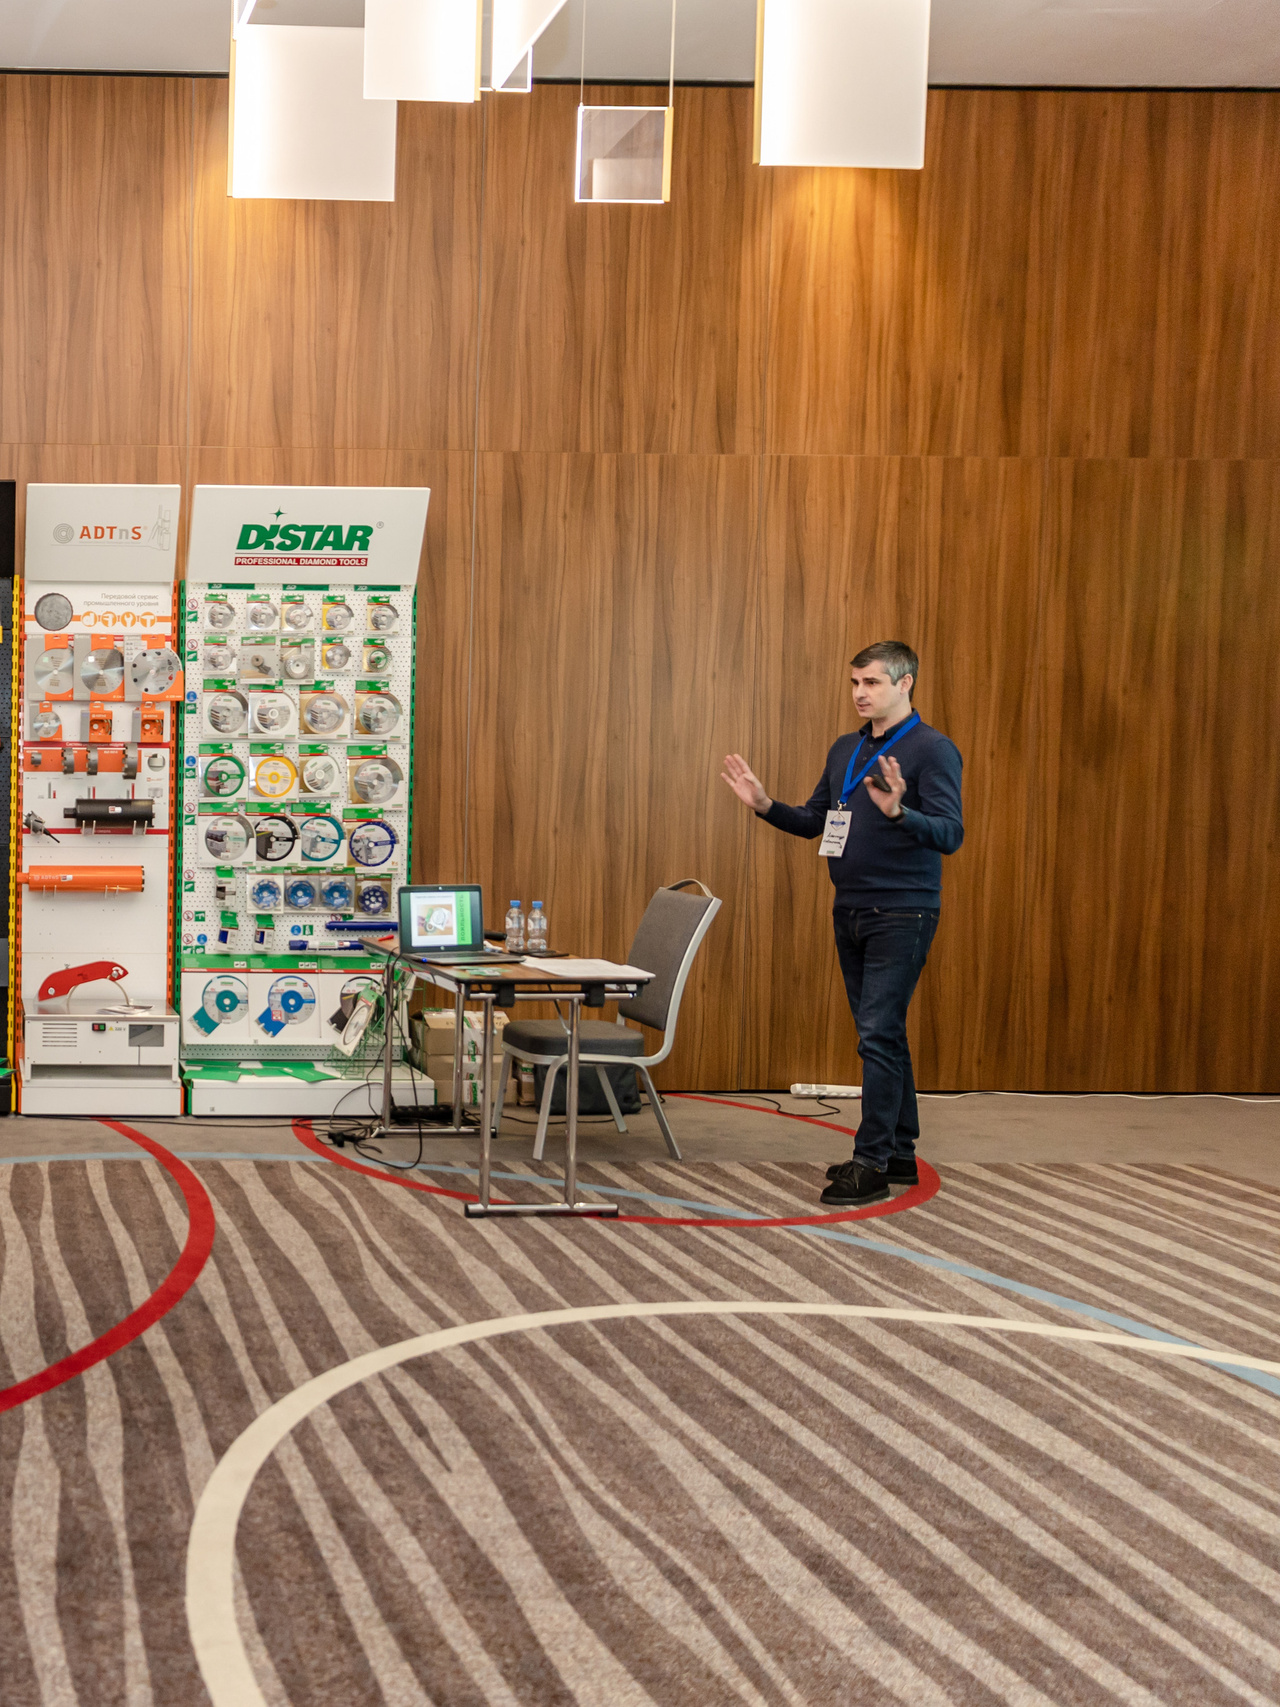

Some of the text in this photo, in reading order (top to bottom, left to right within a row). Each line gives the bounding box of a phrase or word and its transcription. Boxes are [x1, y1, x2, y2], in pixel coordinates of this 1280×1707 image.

[79, 525, 142, 540] ADTnS
[236, 557, 367, 566] PROFESSIONAL DIAMOND TOOLS
